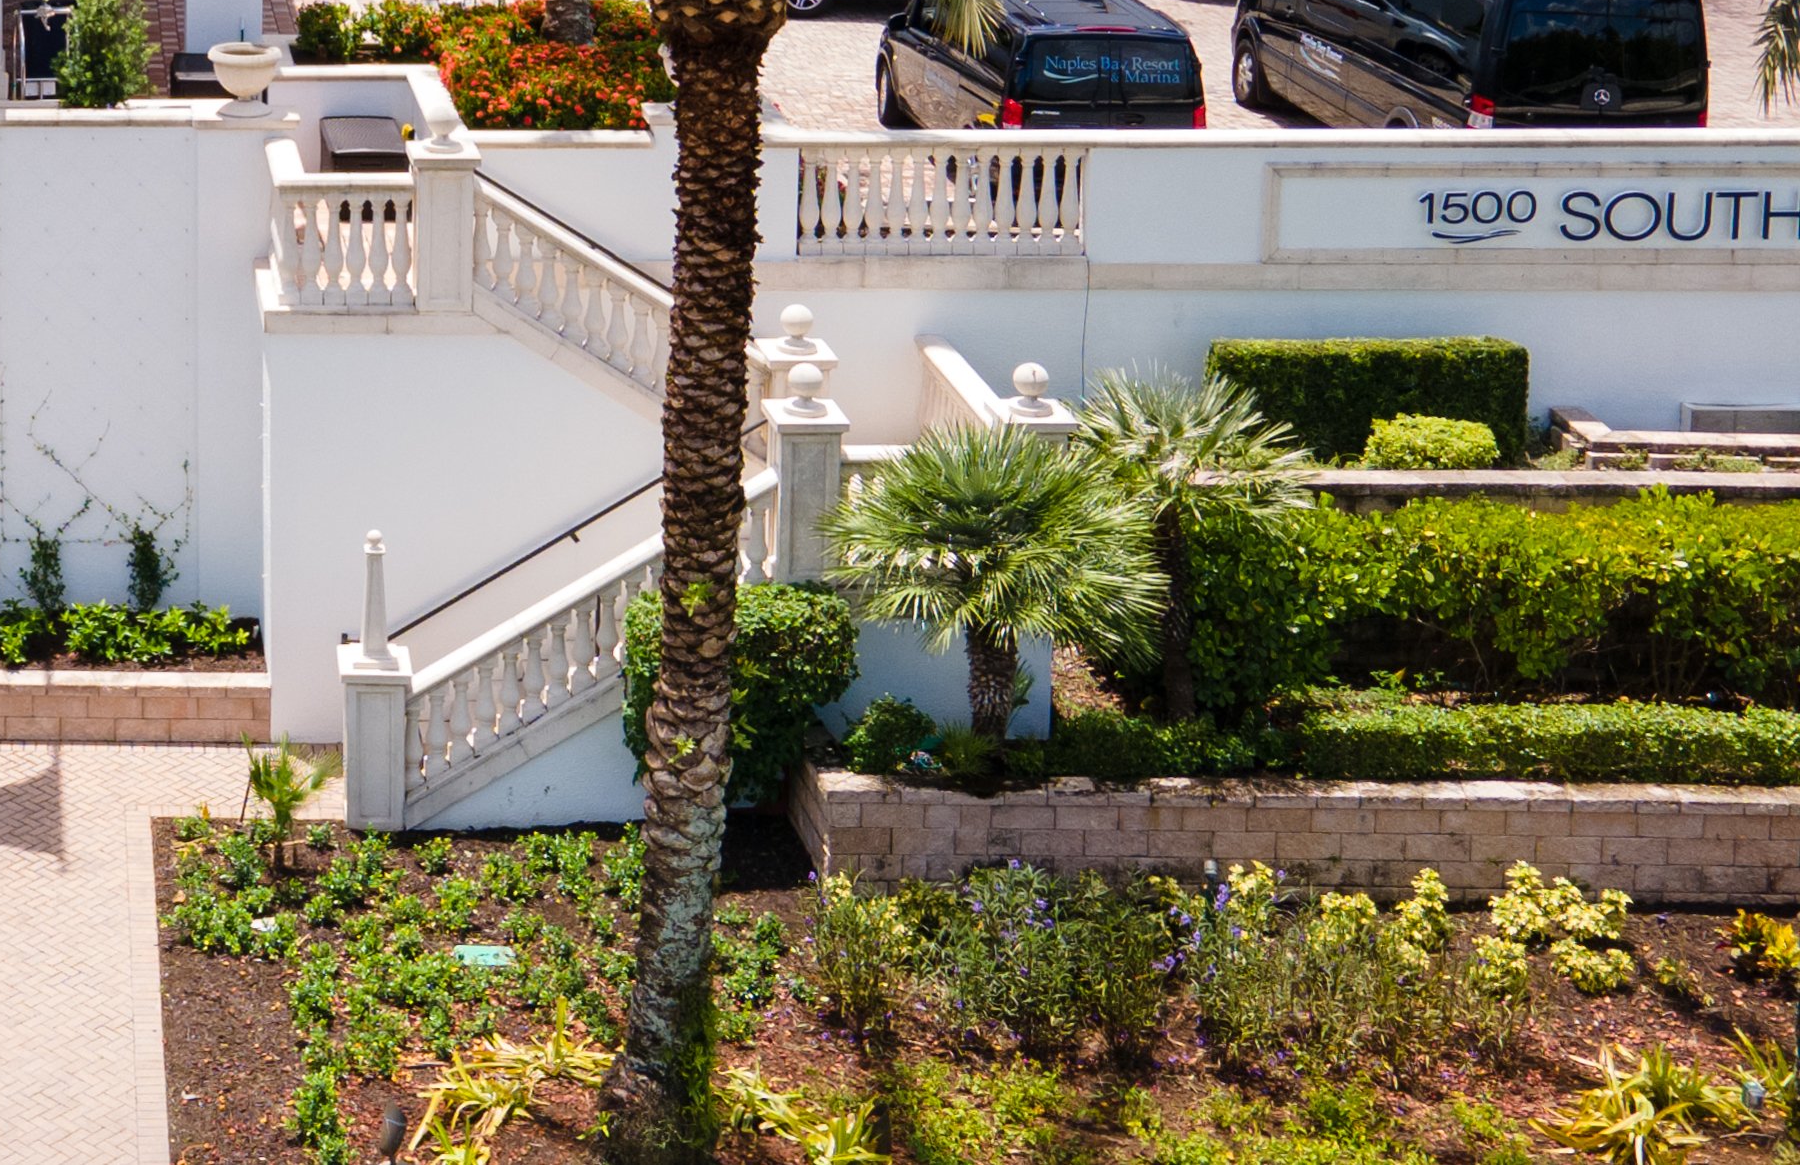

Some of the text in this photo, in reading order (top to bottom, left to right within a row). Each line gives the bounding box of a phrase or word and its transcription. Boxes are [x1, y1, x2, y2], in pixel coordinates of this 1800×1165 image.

[1045, 56, 1097, 73] Naples
[1132, 57, 1180, 71] Resort
[1124, 70, 1180, 83] Marina
[1419, 191, 1800, 241] 1500 SOUTH
